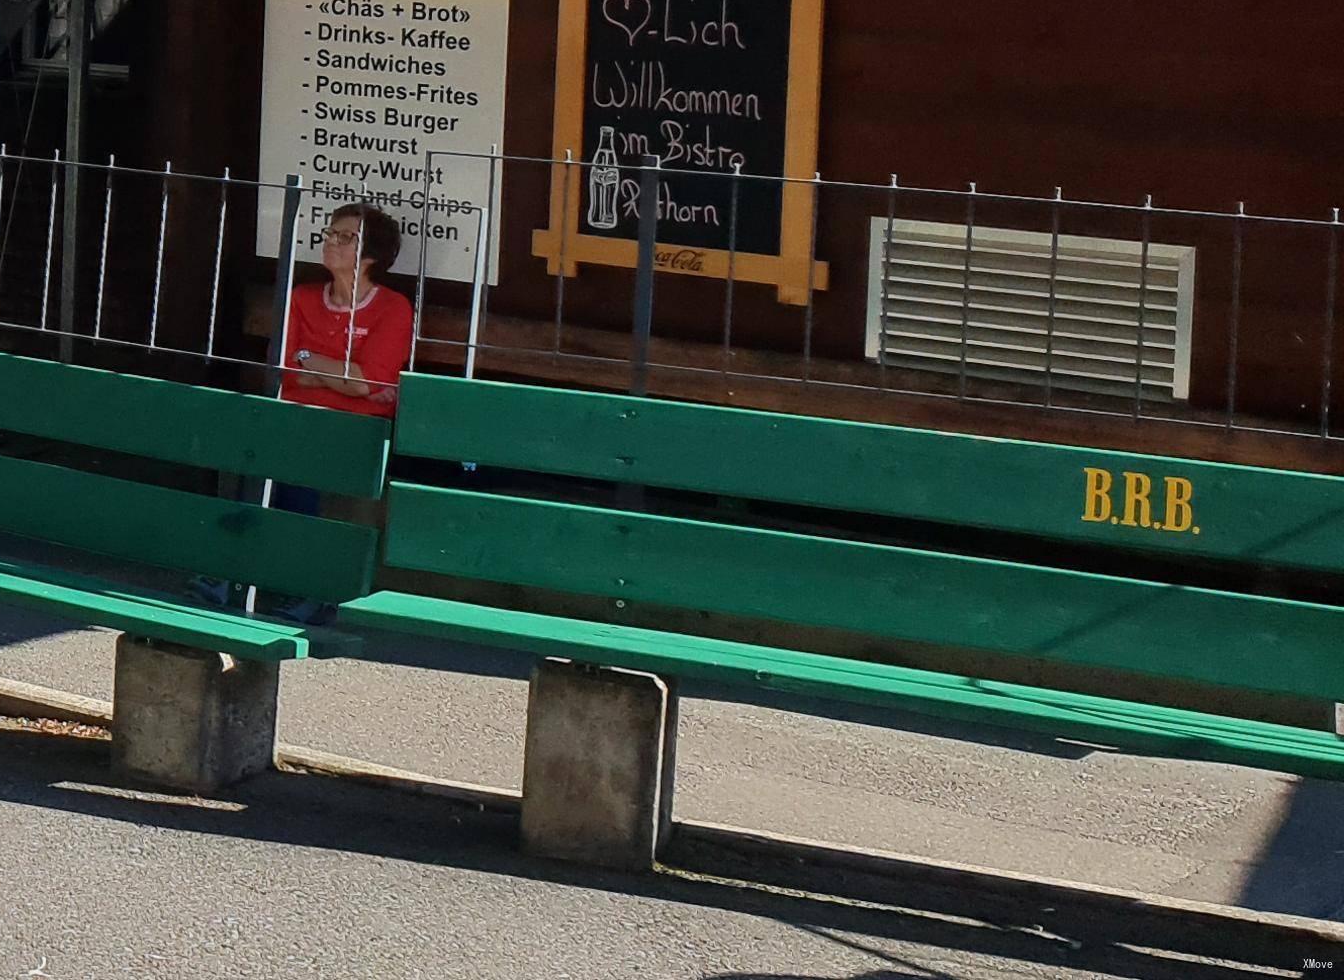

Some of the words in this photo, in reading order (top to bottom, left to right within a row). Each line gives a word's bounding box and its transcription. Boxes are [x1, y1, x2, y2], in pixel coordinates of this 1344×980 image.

[412, 1, 471, 24] Brot»
[318, 24, 395, 45] Drinks-
[401, 28, 471, 51] Kaffee
[317, 50, 447, 77] Sandwiches
[315, 76, 479, 106] Pommes-Frites
[592, 61, 761, 120] Willkommen
[315, 102, 377, 124] Swiss
[384, 107, 459, 133] Burger
[314, 128, 418, 155] Bratwurst
[615, 116, 650, 154] im
[659, 120, 746, 168] Bistro
[313, 155, 443, 185] Curry-Wurst
[311, 180, 356, 202] Fish
[361, 187, 402, 207] and
[410, 190, 473, 217] Chips
[620, 179, 720, 226] Rthorn
[401, 216, 458, 240] icken
[1081, 467, 1201, 535] B.R.B.
